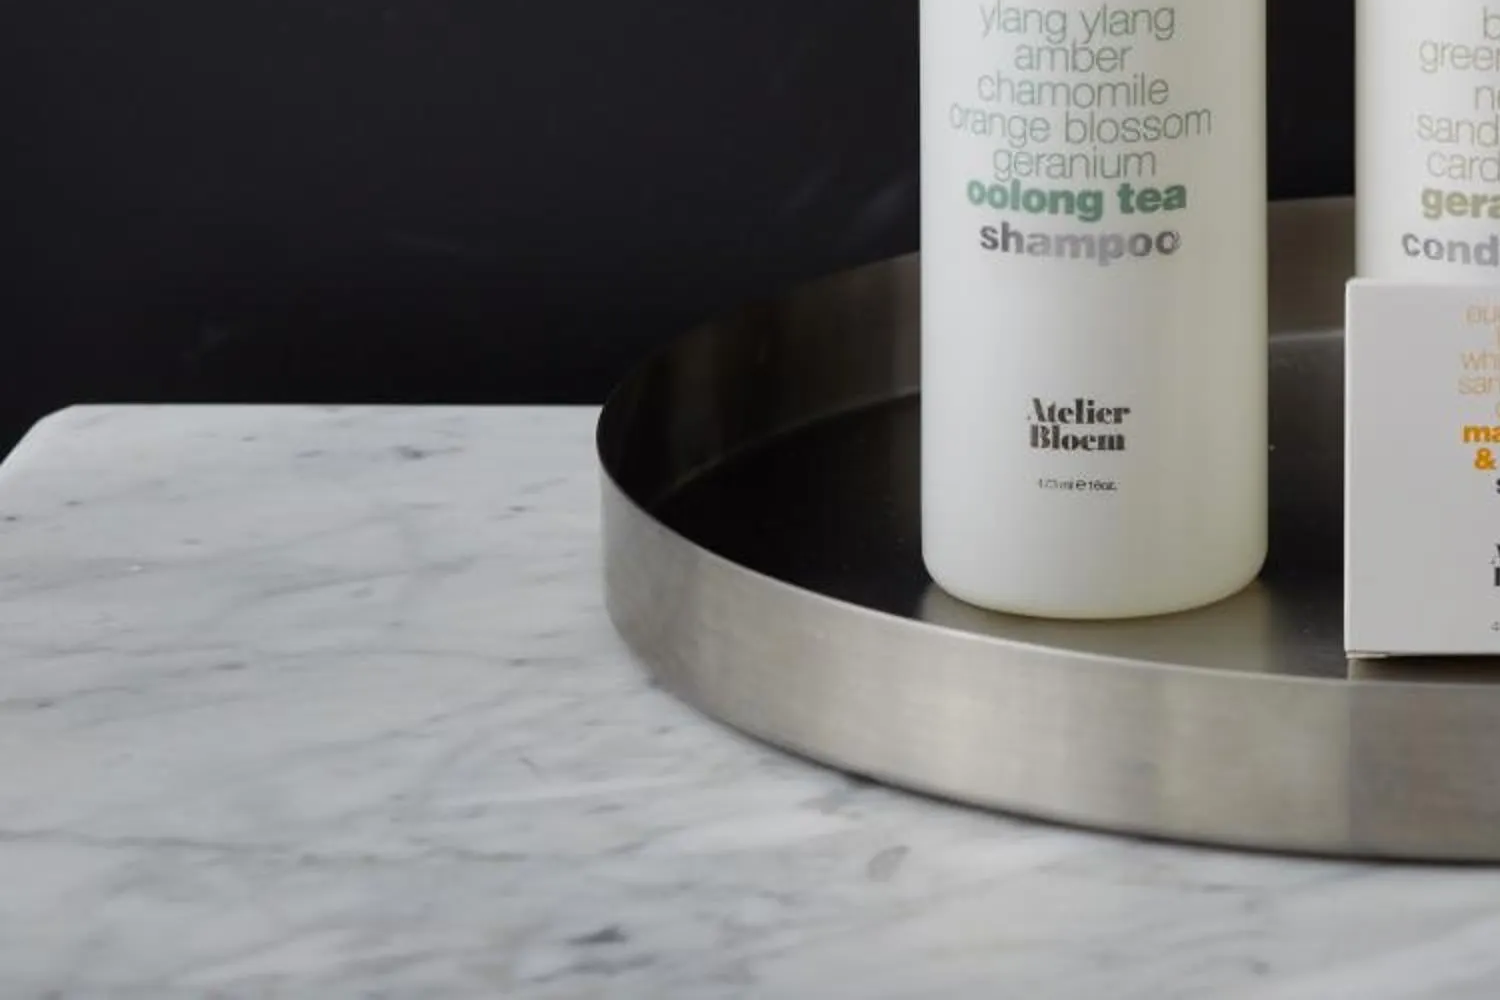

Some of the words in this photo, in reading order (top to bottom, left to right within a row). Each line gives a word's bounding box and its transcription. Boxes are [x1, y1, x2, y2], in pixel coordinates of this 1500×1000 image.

[980, 0, 1067, 45] ylang
[1080, 3, 1176, 43] ylang
[1013, 37, 1132, 73] amber
[976, 70, 1171, 108] chamomile
[950, 102, 1050, 149] orange
[1064, 107, 1213, 145] blossom
[992, 146, 1156, 183] geranium
[966, 178, 1104, 223] oolong
[1116, 181, 1188, 214] tea
[979, 221, 1182, 267] shampoo
[1026, 397, 1131, 425] Atelier
[1029, 424, 1126, 452] Bloem
[1474, 447, 1496, 471] &
